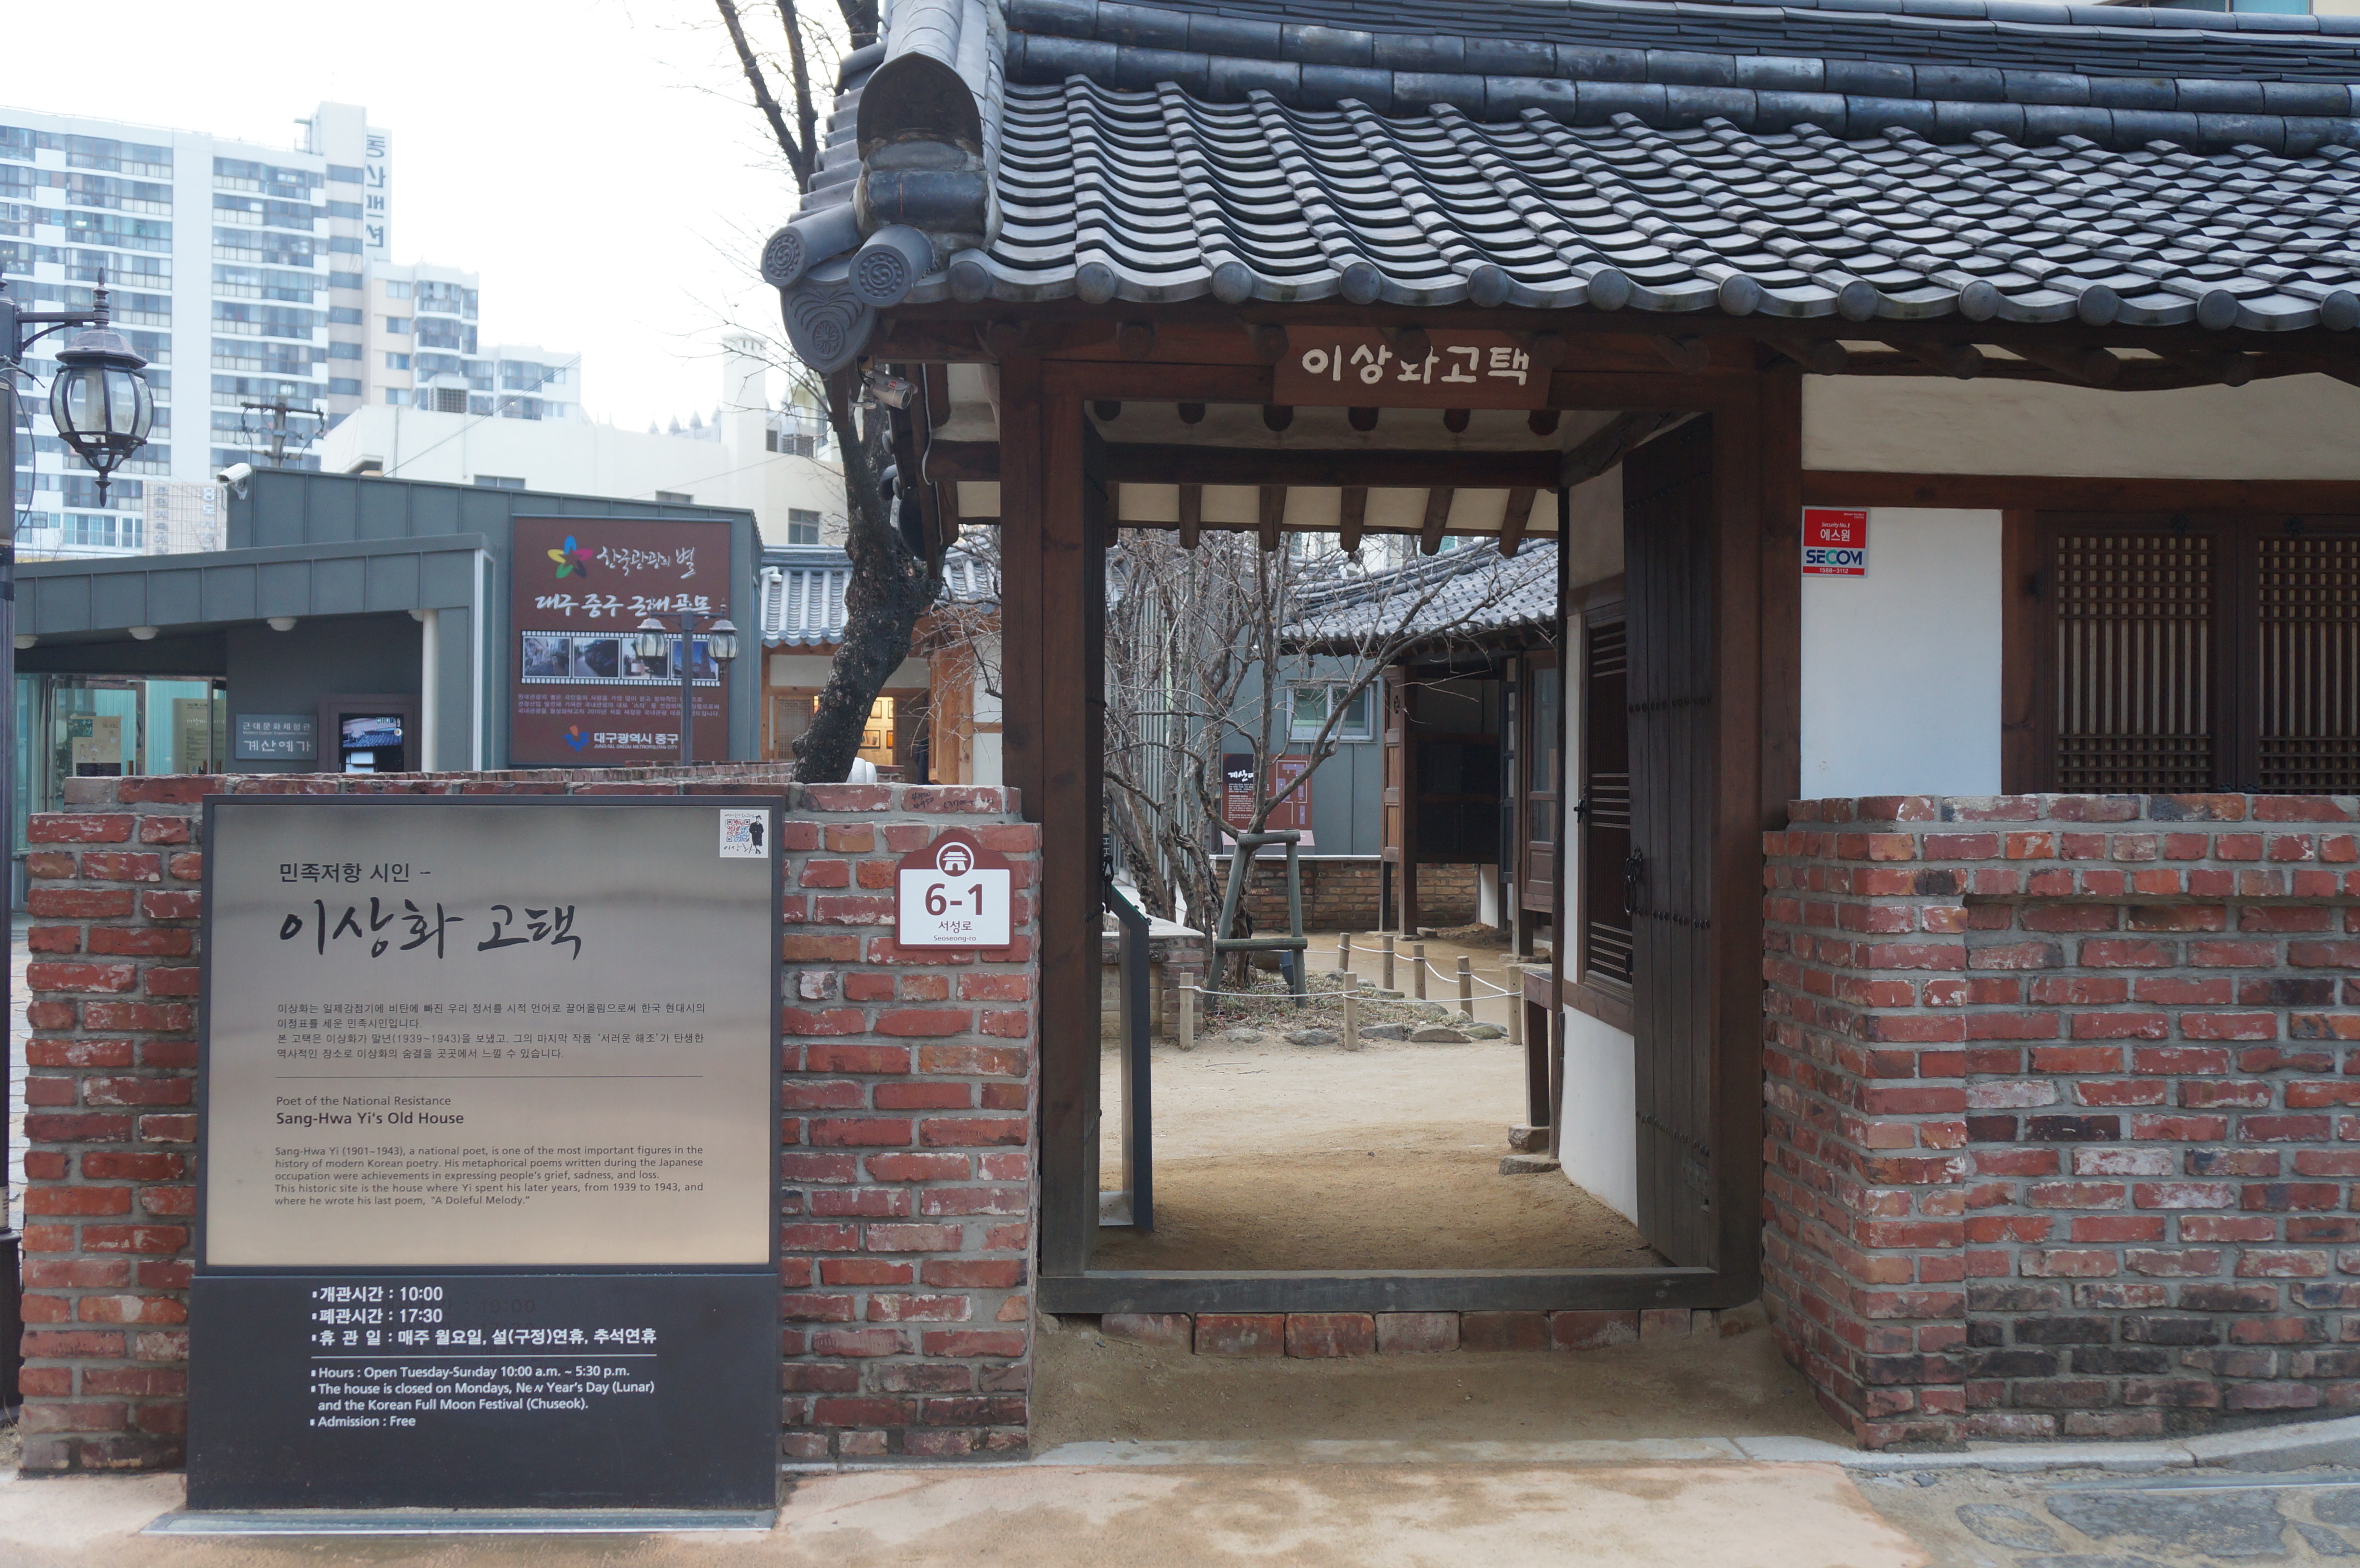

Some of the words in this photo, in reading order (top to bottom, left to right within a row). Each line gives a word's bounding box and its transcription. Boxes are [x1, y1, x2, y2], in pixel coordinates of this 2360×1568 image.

[1820, 528, 1850, 542] 에스원
[596, 545, 670, 577] 한국관광의
[676, 547, 696, 579] 별
[1806, 549, 1863, 565] SECOM
[535, 593, 578, 617] 대구
[581, 593, 624, 618] 중구
[593, 732, 651, 744] 대구광역시
[655, 733, 678, 744] 중구
[243, 740, 311, 753] 계산예가
[280, 863, 362, 883] 민족저항
[369, 863, 409, 883] 시인
[925, 883, 983, 916] 6-1
[280, 896, 465, 959] 이상화
[477, 905, 581, 961] 고택
[938, 920, 973, 934] 서성로
[278, 1004, 319, 1014] 이상화는
[323, 1004, 383, 1014] 일제강점기에
[389, 1004, 418, 1014] 비탄에
[424, 1004, 442, 1014] 빠진
[448, 1004, 467, 1014] 우리
[472, 1003, 502, 1014] 정서를
[506, 1003, 526, 1014] 시적
[531, 1003, 561, 1014] 언어로
[565, 1003, 636, 1014] 끌어올림으로써
[641, 1003, 661, 1013] 한국
[665, 1003, 705, 1013] 현대시의
[277, 1018, 319, 1029] 이정표를
[322, 1018, 343, 1029] 세운
[347, 1018, 421, 1029] 민족시인입니다.
[277, 1034, 287, 1044] 본
[292, 1034, 322, 1044] 고택은
[326, 1034, 367, 1044] 이상화가
[475, 1033, 508, 1044] 보냈고,
[513, 1033, 532, 1043] 그의
[538, 1033, 568, 1044] 마지막
[572, 1033, 591, 1043] 작품
[674, 1033, 704, 1043] 탄생한
[277, 1049, 317, 1059] 역사적인
[322, 1049, 353, 1059] 장소로
[357, 1049, 397, 1059] 이상화의
[402, 1048, 432, 1059] 숨결을
[437, 1048, 477, 1059] 곳곳에서
[482, 1048, 501, 1059] 느낄
[506, 1049, 516, 1059] 수
[520, 1048, 564, 1059] 있습니다.
[276, 1096, 302, 1105] Poet
[305, 1095, 317, 1105] of
[320, 1096, 339, 1105] the
[343, 1096, 390, 1105] National
[394, 1096, 451, 1105] Resistance
[276, 1112, 352, 1127] Sang-Hwa
[388, 1111, 413, 1124] Old
[418, 1112, 464, 1124] House
[275, 1147, 325, 1157] Sang-Hwa
[329, 1147, 339, 1155] Yi
[418, 1146, 459, 1155] national
[463, 1147, 488, 1157] poet,
[492, 1146, 499, 1155] is
[524, 1146, 535, 1155] of
[537, 1146, 554, 1155] the
[584, 1146, 634, 1156] important
[637, 1145, 671, 1156] figures
[675, 1145, 683, 1154] in
[687, 1145, 703, 1154] the
[275, 1159, 309, 1170] history
[312, 1159, 323, 1168] of
[326, 1159, 364, 1168] modern
[368, 1159, 403, 1167] Korean
[406, 1160, 441, 1170] poetry.
[444, 1159, 459, 1167] His
[462, 1158, 527, 1169] metaphorical
[530, 1160, 562, 1169] poems
[565, 1158, 601, 1167] written
[604, 1158, 637, 1169] during
[639, 1158, 656, 1166] the
[659, 1158, 703, 1169] Japanese
[275, 1172, 330, 1182] occupation
[361, 1171, 429, 1180] achievements
[432, 1171, 442, 1179] in
[444, 1171, 496, 1182] expressing
[544, 1170, 570, 1182] grief,
[574, 1170, 614, 1180] sadness,
[617, 1170, 636, 1179] and
[639, 1170, 659, 1179] loss.
[319, 1286, 383, 1302] 개관시간
[400, 1286, 443, 1301] 10:00
[319, 1308, 383, 1324] 폐관시간
[399, 1308, 443, 1323] 17:30
[319, 1330, 335, 1346] 휴
[342, 1330, 359, 1346] 관
[366, 1330, 381, 1346] 일
[398, 1329, 430, 1346] 매주
[435, 1329, 487, 1345] 월요일,
[492, 1328, 588, 1345] 설(구정)연휴,
[593, 1328, 657, 1344] 추석연휴
[319, 1367, 355, 1378] Hours
[364, 1367, 397, 1380] Open
[400, 1365, 497, 1380] Tuesday-Sunday
[501, 1366, 532, 1377] 10:00
[535, 1368, 561, 1377] a.m.
[576, 1365, 601, 1376] 5:30
[603, 1367, 630, 1379] p.m.
[318, 1383, 341, 1395] The
[344, 1383, 381, 1394] house
[383, 1383, 393, 1394] is
[395, 1382, 432, 1394] closed
[435, 1385, 452, 1394] on
[455, 1382, 512, 1396] Mondays,
[586, 1382, 609, 1395] Day
[612, 1381, 655, 1394] (Lunar)
[318, 1399, 342, 1411] and
[344, 1399, 365, 1410] the
[368, 1399, 412, 1410] Korean
[415, 1398, 436, 1410] Full
[440, 1399, 476, 1410] Moon
[479, 1398, 523, 1410] Festival
[526, 1397, 589, 1411] (Chuseok).
[318, 1415, 380, 1427] Admission
[390, 1415, 416, 1427] Free
